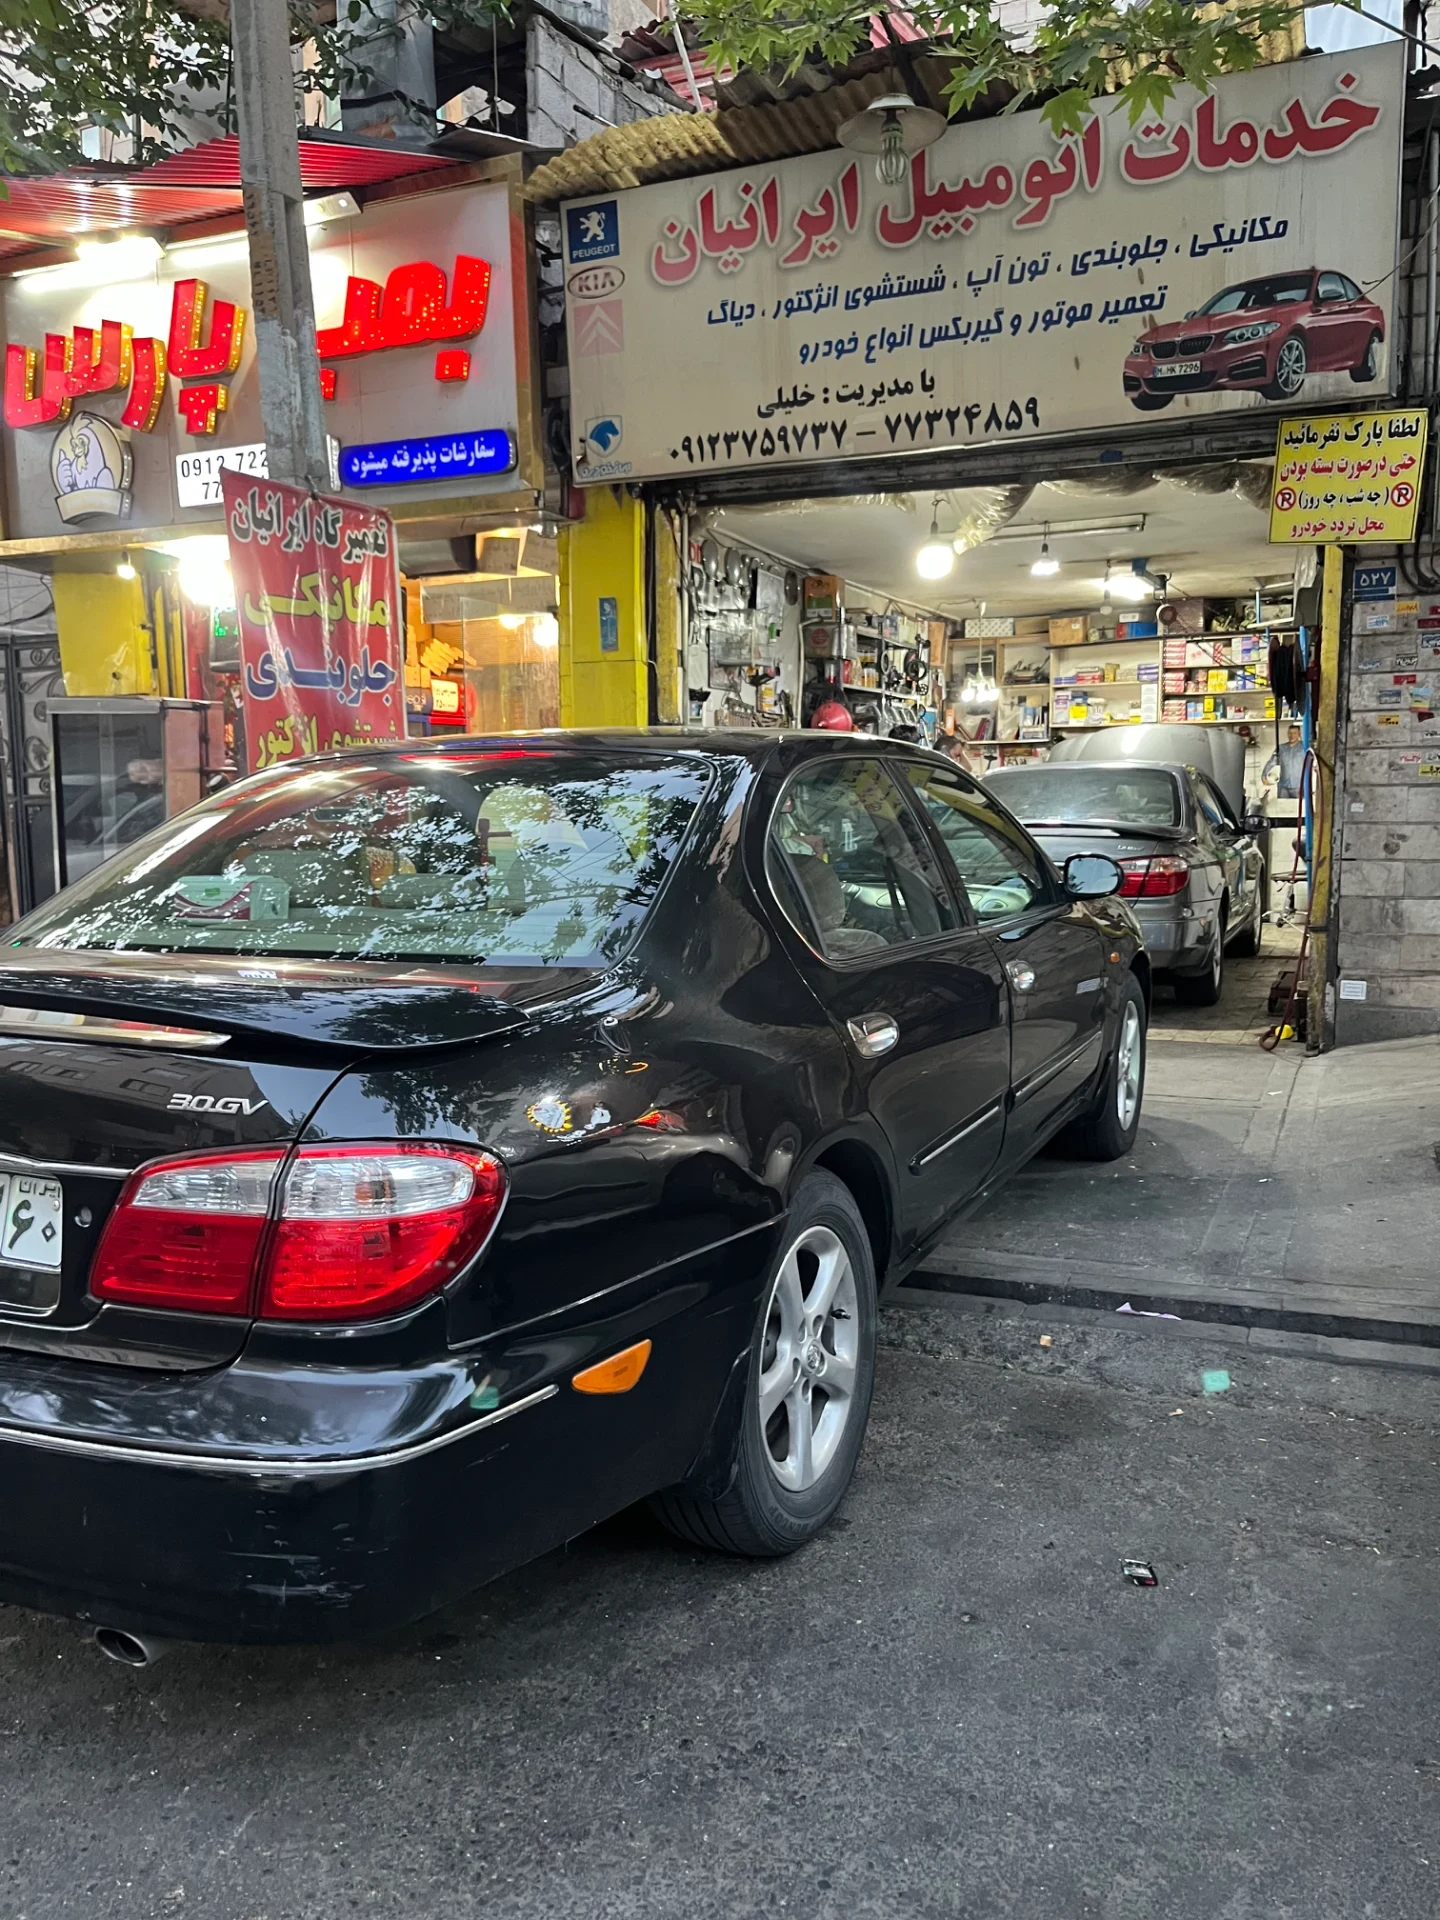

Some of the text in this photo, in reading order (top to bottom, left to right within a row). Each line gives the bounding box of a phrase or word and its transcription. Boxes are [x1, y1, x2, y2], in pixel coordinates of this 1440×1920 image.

[654, 71, 1381, 283] خدمات اتومبیل ایرانیان
[572, 243, 616, 259] PEUGEOT
[1189, 215, 1289, 258] مکانیکی
[1007, 251, 1051, 286] تون
[1070, 234, 1168, 277] جلوبندی
[577, 271, 616, 294] KIA
[843, 263, 947, 311] شستشوی
[966, 254, 1004, 298] آپ
[706, 299, 755, 327] دیاگ
[771, 282, 839, 320] انژکتور
[798, 284, 1169, 365] تعمیر موتور و گیربکس انواع خودرو
[4, 277, 247, 436] پارس
[1178, 362, 1200, 373] 7296
[757, 383, 816, 419] خلیلی
[836, 377, 914, 408] مدیریت
[920, 368, 935, 399] با
[884, 396, 1040, 444] ۷۷۳۲۴۸۵۹
[1283, 416, 1421, 450] لطفا پارک نفرمائید
[351, 436, 496, 479] سفارشات پذیرفته میشود
[669, 419, 848, 465] ۰۹۱۲۳۷۵۹۷۳۷
[1280, 461, 1308, 482] بودن
[1310, 457, 1334, 479] بسته
[1388, 453, 1417, 477] حتی
[1345, 488, 1365, 506] شب
[231, 486, 309, 552] ایرانیان
[1290, 516, 1385, 538] محل تردد خودرو
[1360, 571, 1392, 587] ۵۲۷
[244, 570, 391, 634] مکانیکی
[245, 645, 397, 707] جلوبندی
[19, 1181, 61, 1199] ایران
